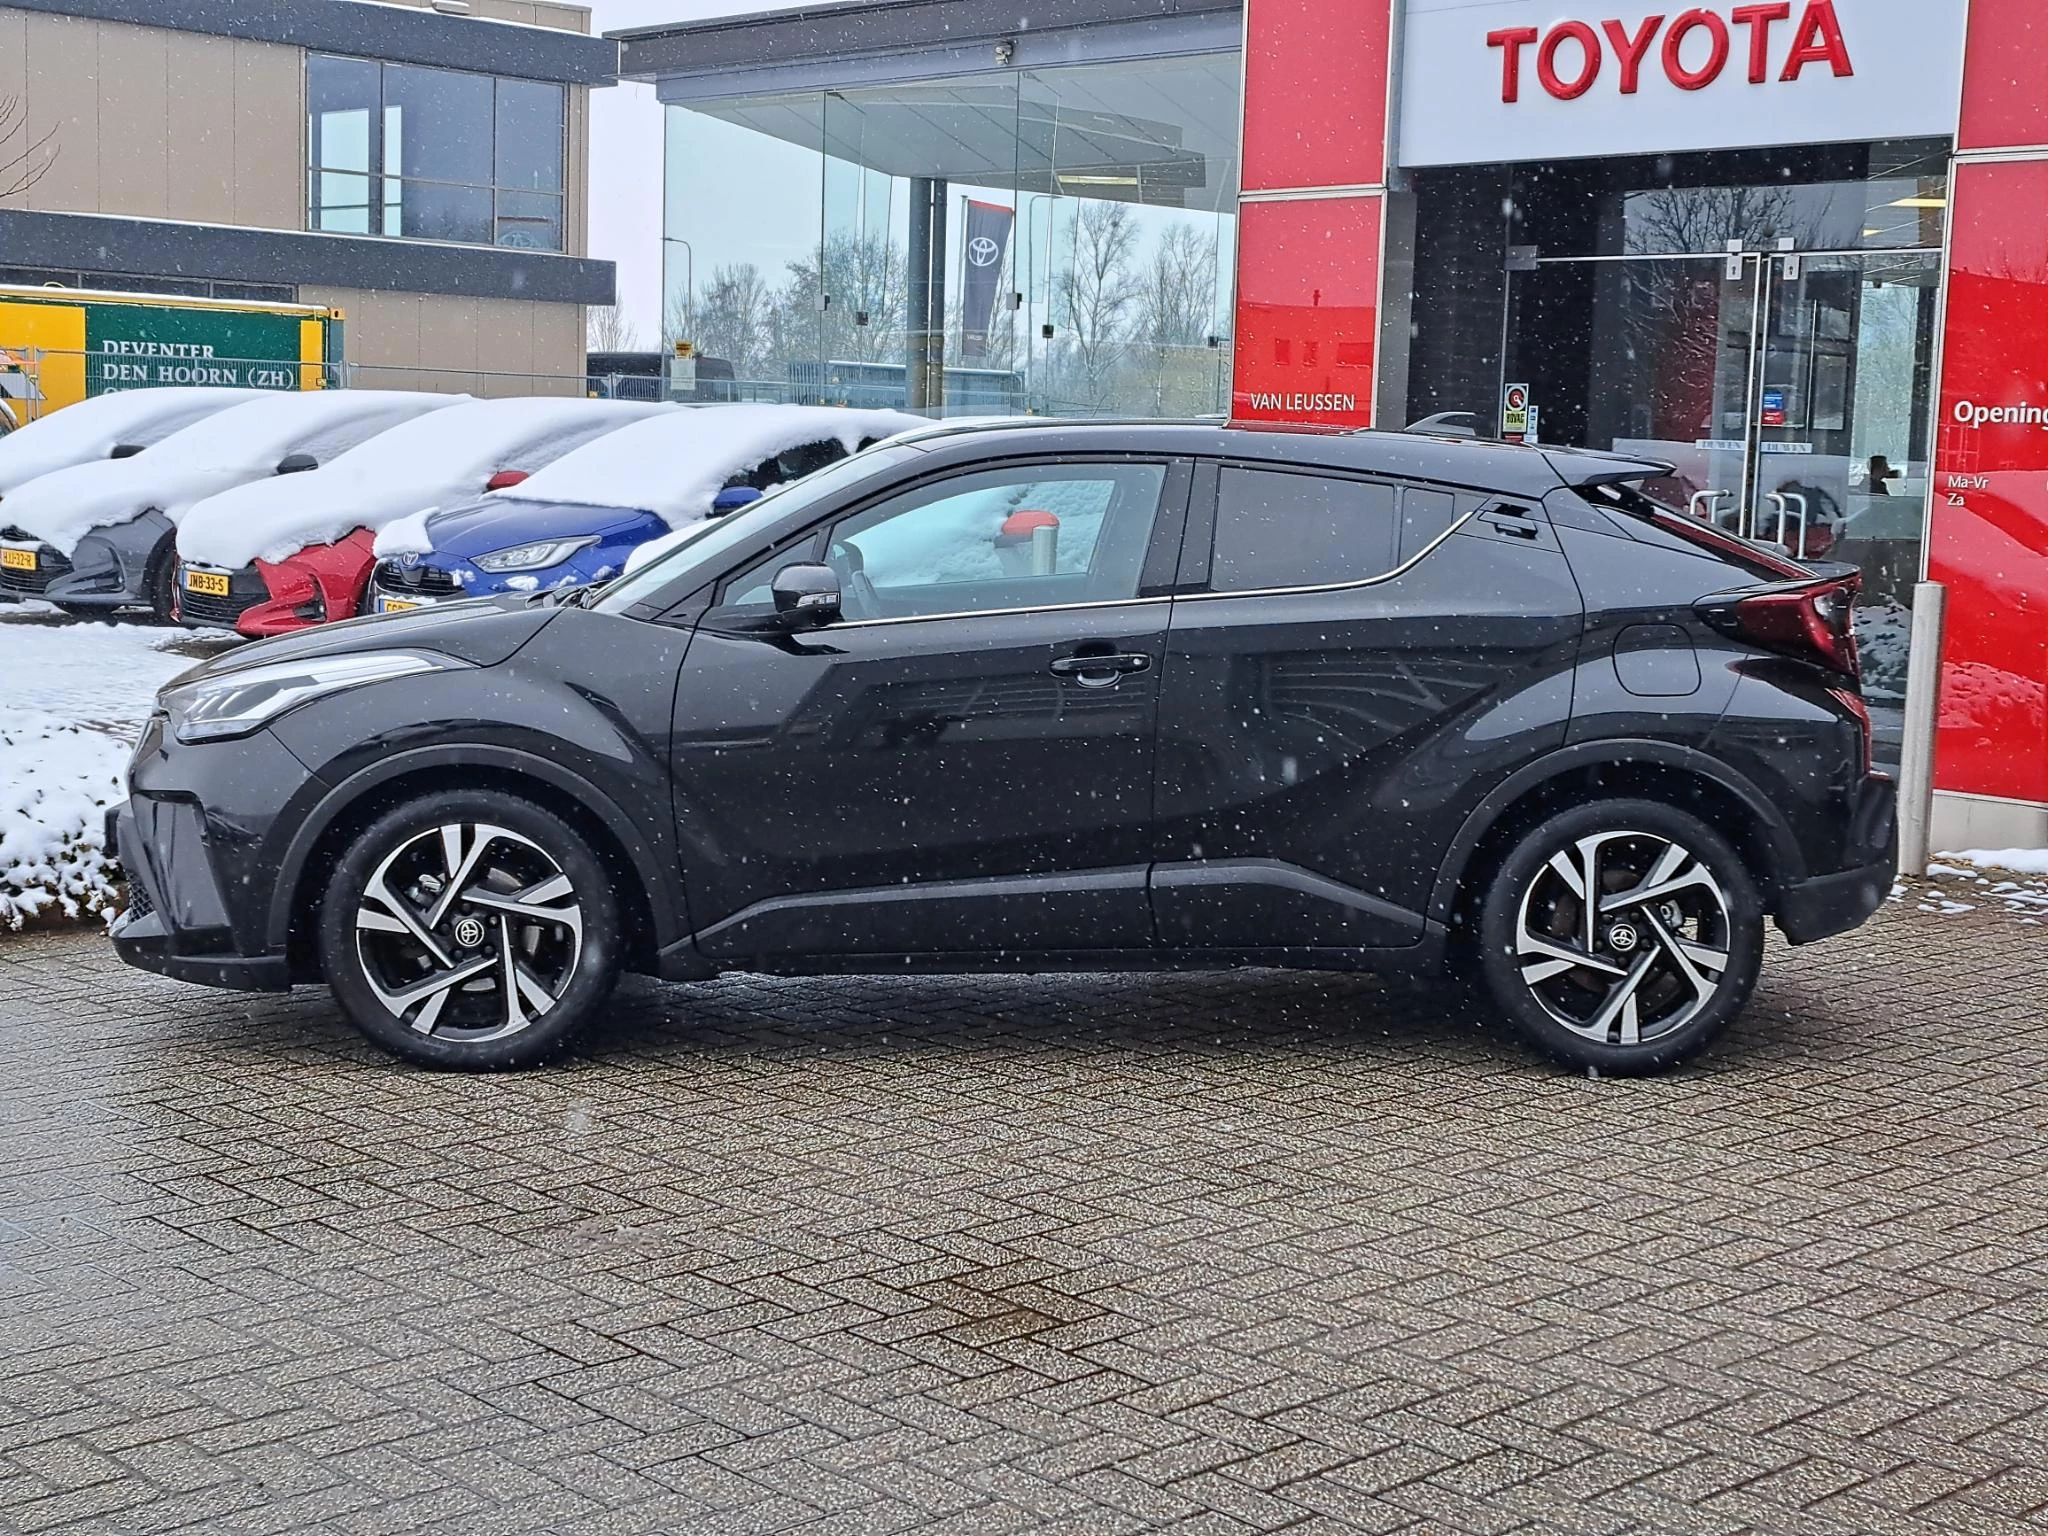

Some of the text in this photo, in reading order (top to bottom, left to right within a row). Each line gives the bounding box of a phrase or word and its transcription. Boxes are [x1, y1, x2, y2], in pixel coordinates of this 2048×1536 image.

[1486, 0, 1854, 103] TOYOTA
[103, 340, 214, 359] DEVENTER
[103, 363, 294, 389] DEN HOORN (ZH)
[1250, 392, 1355, 411] VAN LEUSSEN
[1947, 475, 1989, 489] Ma-Vr
[1947, 492, 1965, 506] Za
